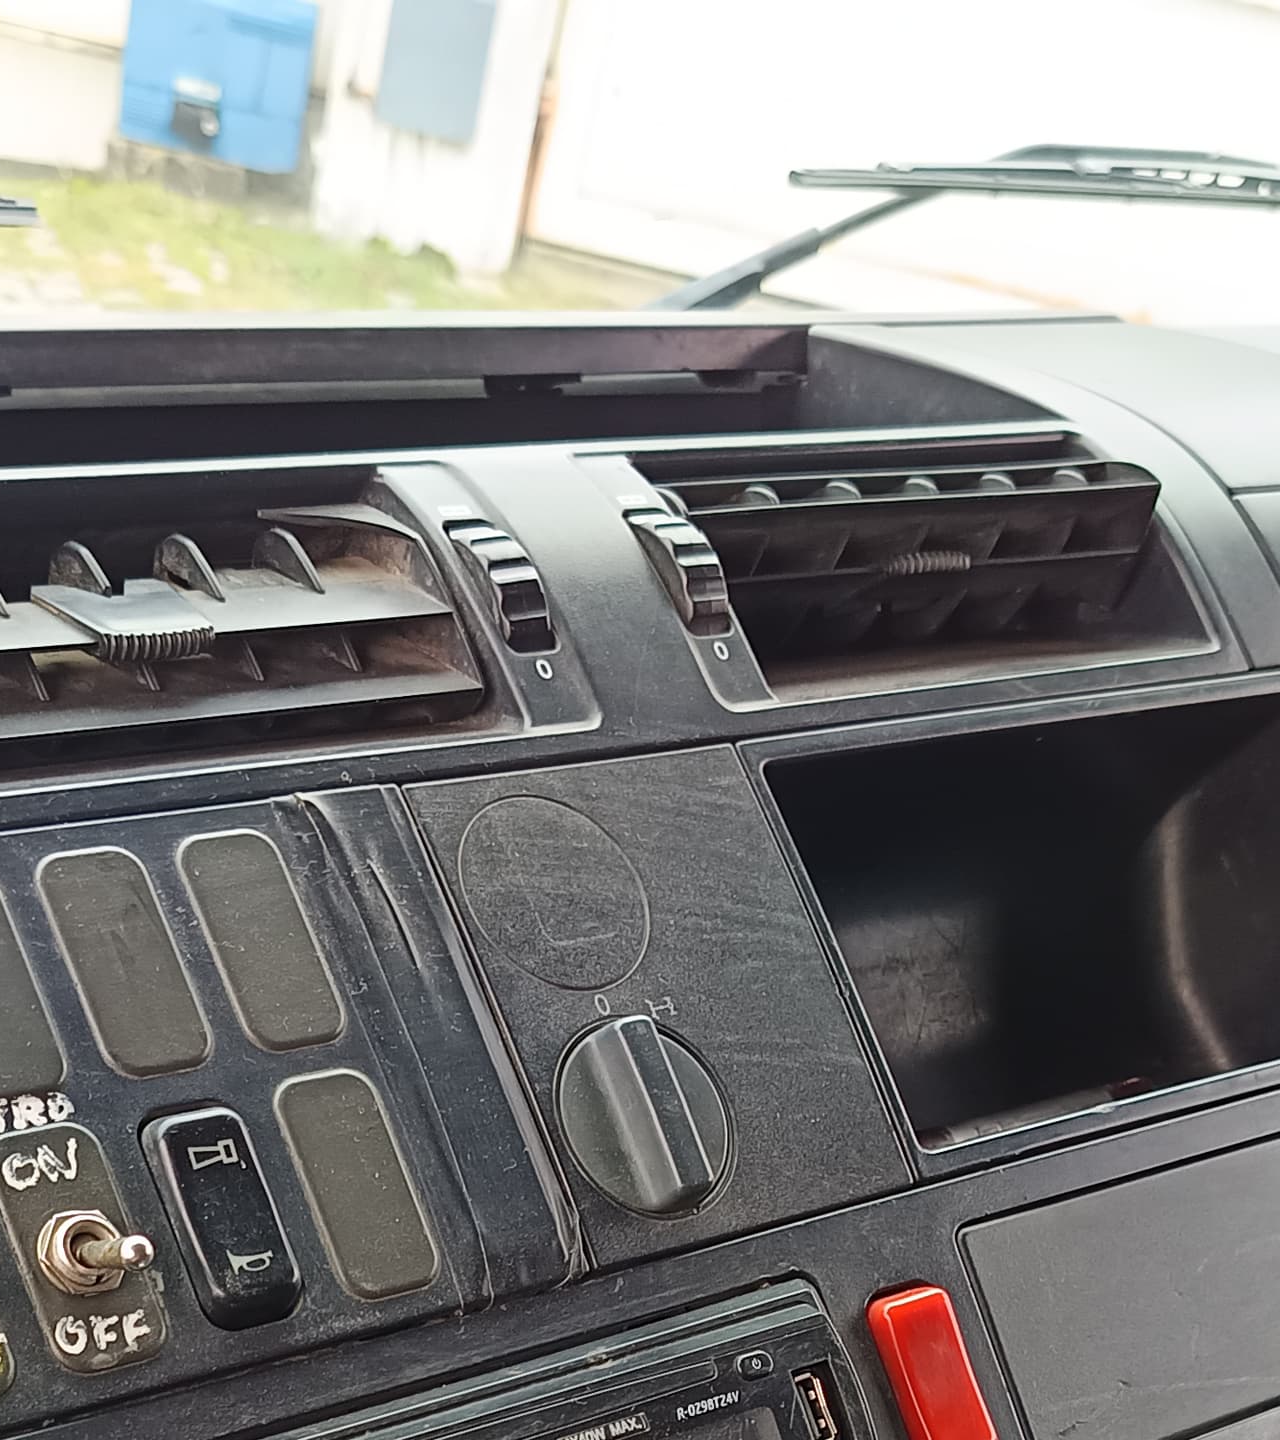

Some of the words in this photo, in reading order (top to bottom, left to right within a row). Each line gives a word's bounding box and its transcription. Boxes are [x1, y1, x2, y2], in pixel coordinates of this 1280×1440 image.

[713, 641, 730, 661] 0
[536, 659, 553, 680] 0
[1, 1137, 78, 1191] ON
[55, 1308, 152, 1356] OFF
